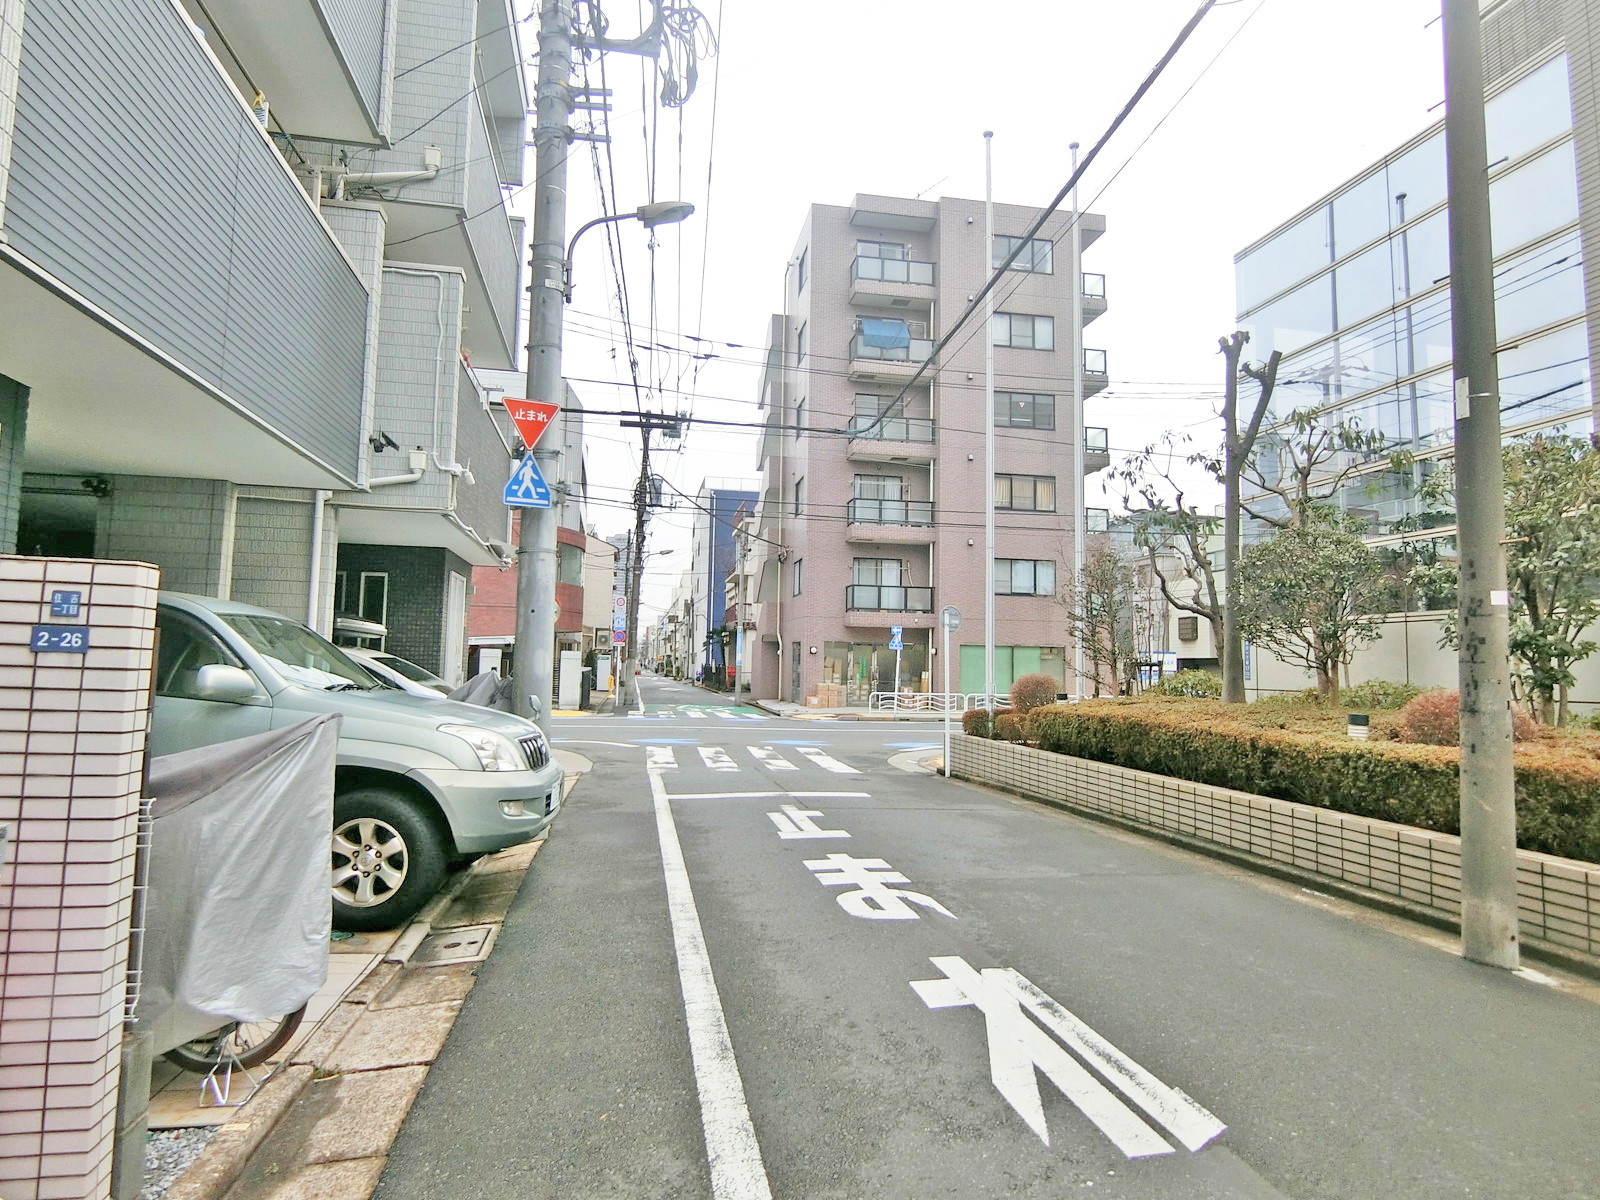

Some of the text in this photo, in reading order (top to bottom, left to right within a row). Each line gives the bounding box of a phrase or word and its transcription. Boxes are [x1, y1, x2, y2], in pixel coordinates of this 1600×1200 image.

[514, 409, 548, 422] 止まれ
[53, 604, 77, 614] 一丁目
[37, 631, 83, 647] 2-26
